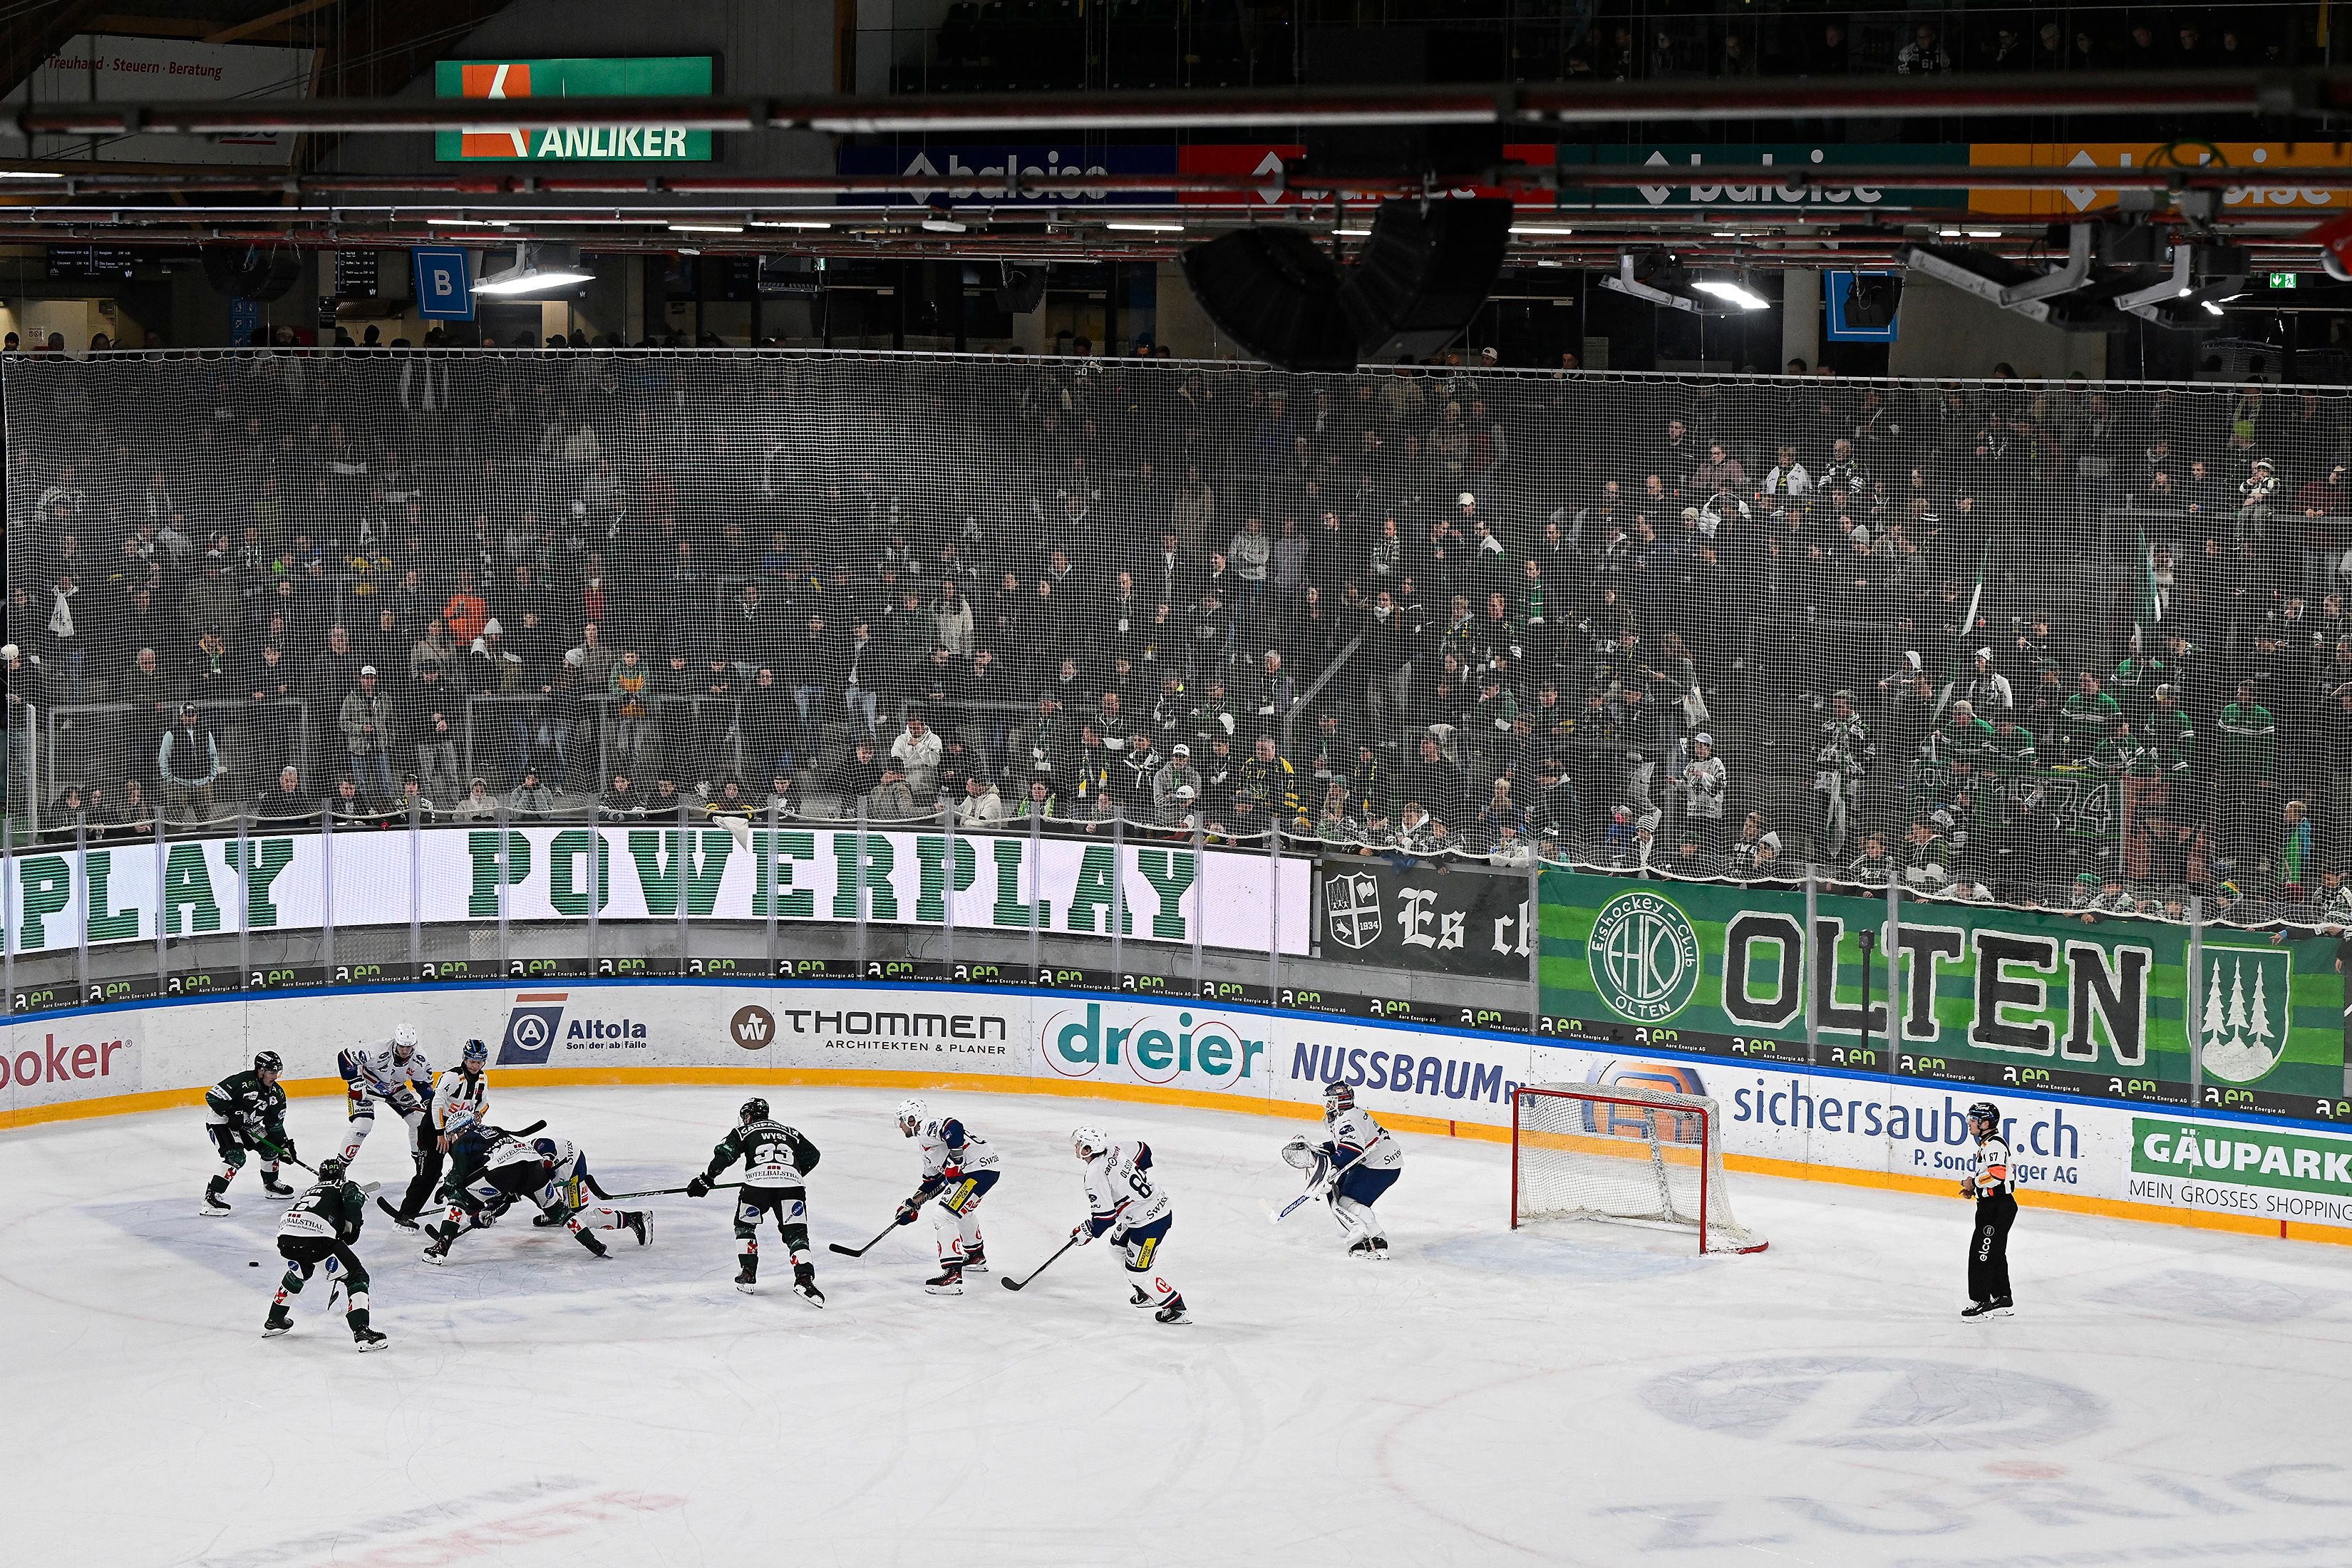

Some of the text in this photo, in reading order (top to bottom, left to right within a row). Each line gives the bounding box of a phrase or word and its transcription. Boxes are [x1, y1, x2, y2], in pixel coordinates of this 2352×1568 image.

[48, 56, 223, 81] Treuhand Steuern Beratung
[538, 125, 687, 157] ANLIKER
[433, 269, 453, 296] B
[0, 838, 294, 952] PLAY
[468, 830, 1195, 940] POWERPLAY
[1397, 887, 1466, 950] Es
[1721, 910, 2154, 1066] OLTEN
[1615, 995, 1671, 1018] OLTEN
[567, 1018, 648, 1040] Altola
[785, 1009, 1006, 1041] THOMMEN
[825, 1039, 1006, 1055] ARCHITEKTEN & PLANER
[1057, 1003, 1264, 1079] dreier
[443, 1083, 450, 1093] 4
[253, 1099, 269, 1111] 73
[1733, 1078, 2078, 1160] sichersaubr.ch
[2316, 1099, 2352, 1119] a.e
[760, 1133, 788, 1141] WYSS
[753, 1143, 795, 1165] 33
[1914, 1148, 1927, 1167] P.
[2053, 1167, 2078, 1185] AG
[2143, 1128, 2352, 1183] GÄUPARK
[2130, 1179, 2352, 1221] MEIN GROSSES SHOPPING
[1978, 1237, 1991, 1262] elco
